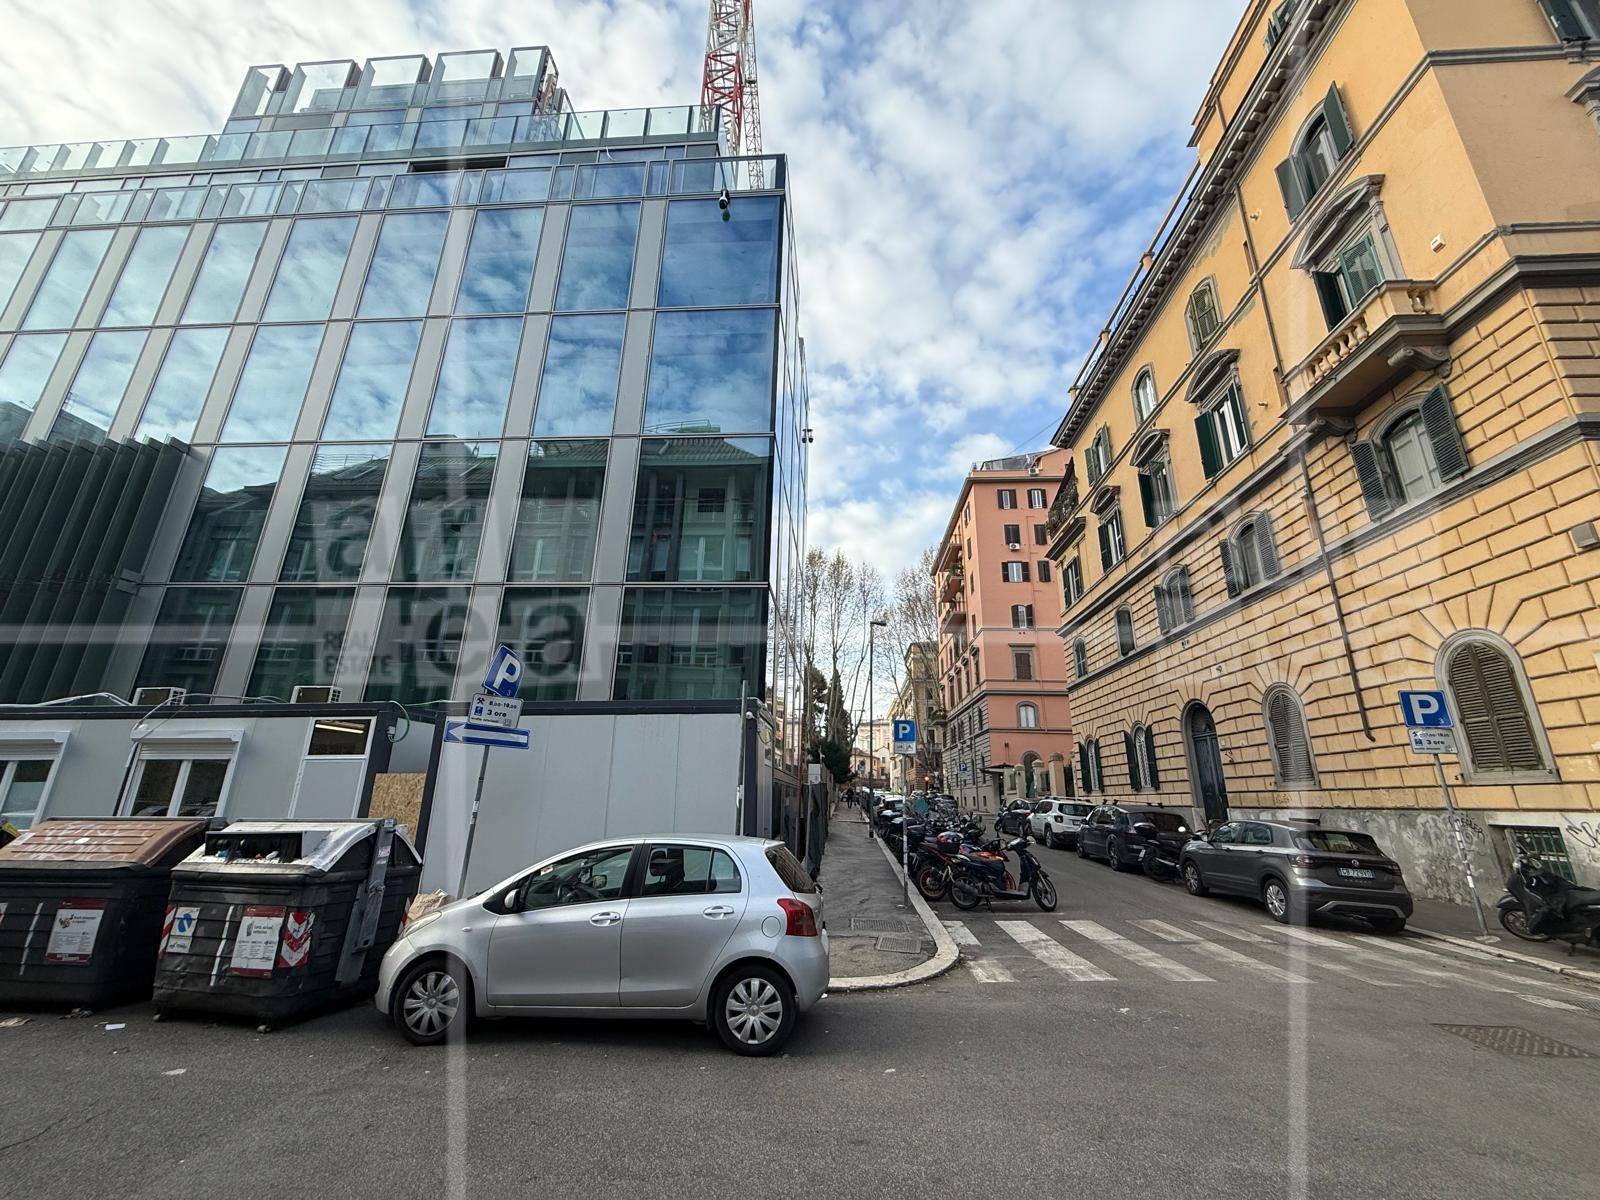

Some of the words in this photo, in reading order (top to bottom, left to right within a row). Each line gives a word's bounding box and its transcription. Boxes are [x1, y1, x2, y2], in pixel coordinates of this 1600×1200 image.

[492, 653, 521, 690] P
[1409, 694, 1439, 724] P
[898, 723, 911, 739] P
